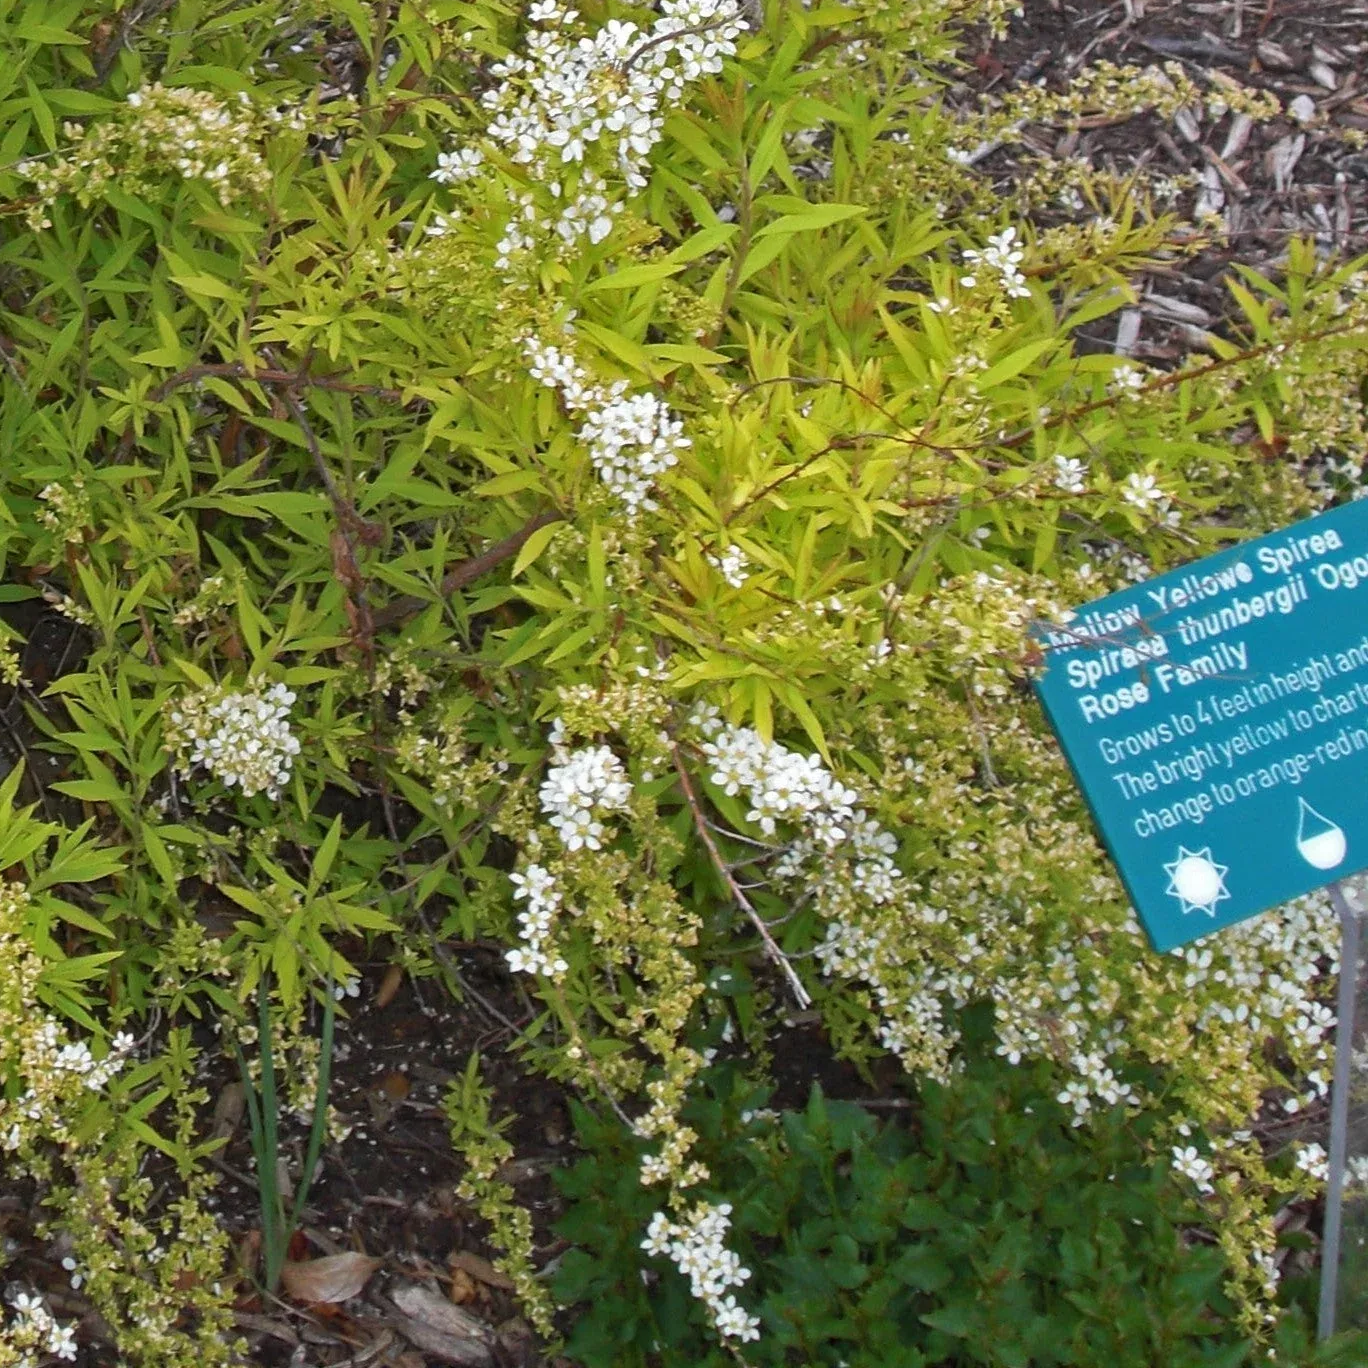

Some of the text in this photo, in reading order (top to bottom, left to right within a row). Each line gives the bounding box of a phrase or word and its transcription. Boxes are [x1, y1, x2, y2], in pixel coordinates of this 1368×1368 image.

[1257, 529, 1343, 574] Spirea
[1067, 554, 1368, 689] Spiraea thunbergii 'Ogo
[1078, 641, 1247, 723] Rose Family
[1099, 723, 1173, 764] Grows
[1170, 714, 1196, 736] to
[1196, 700, 1213, 724] 4
[1210, 686, 1255, 721] feet
[1250, 680, 1276, 704] in
[1270, 654, 1337, 697] height
[1113, 772, 1158, 800] The
[1153, 742, 1220, 784] bright
[1217, 718, 1288, 768] yellow
[1287, 709, 1313, 732] to
[1134, 793, 1213, 837] change
[1210, 783, 1235, 805] to
[1235, 729, 1352, 797] orange-red
